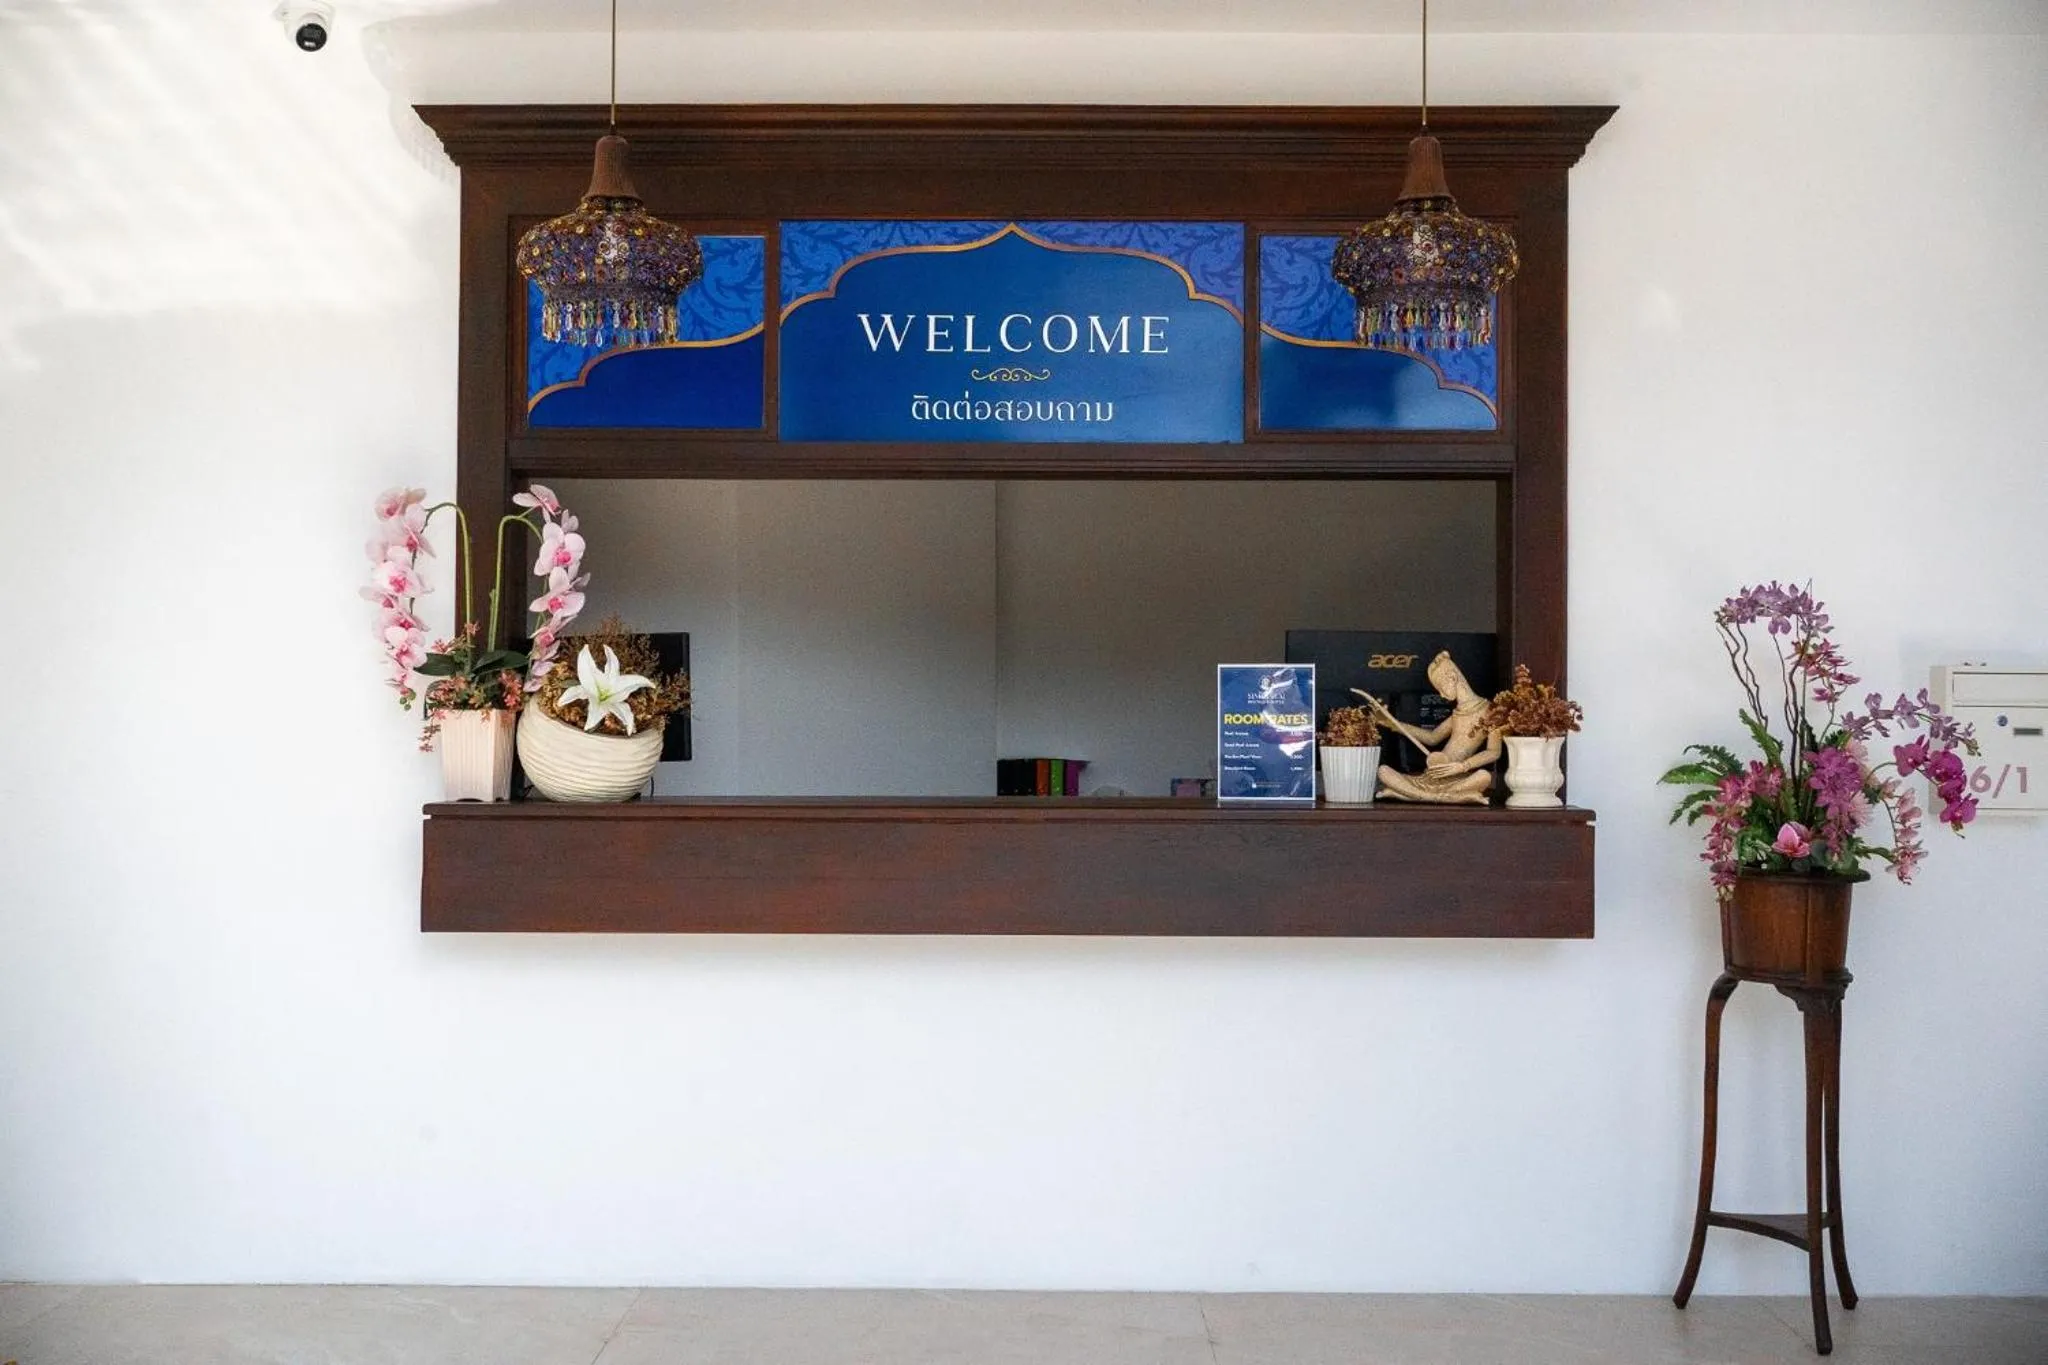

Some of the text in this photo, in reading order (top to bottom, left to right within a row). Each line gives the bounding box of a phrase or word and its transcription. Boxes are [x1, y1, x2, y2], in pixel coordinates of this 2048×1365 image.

[857, 313, 1169, 353] WELCOME
[911, 390, 1113, 421] ติดต่อสอบถาม
[1367, 654, 1419, 668] acer
[1224, 713, 1264, 724] ROOM
[1970, 764, 2028, 799] 6/1
